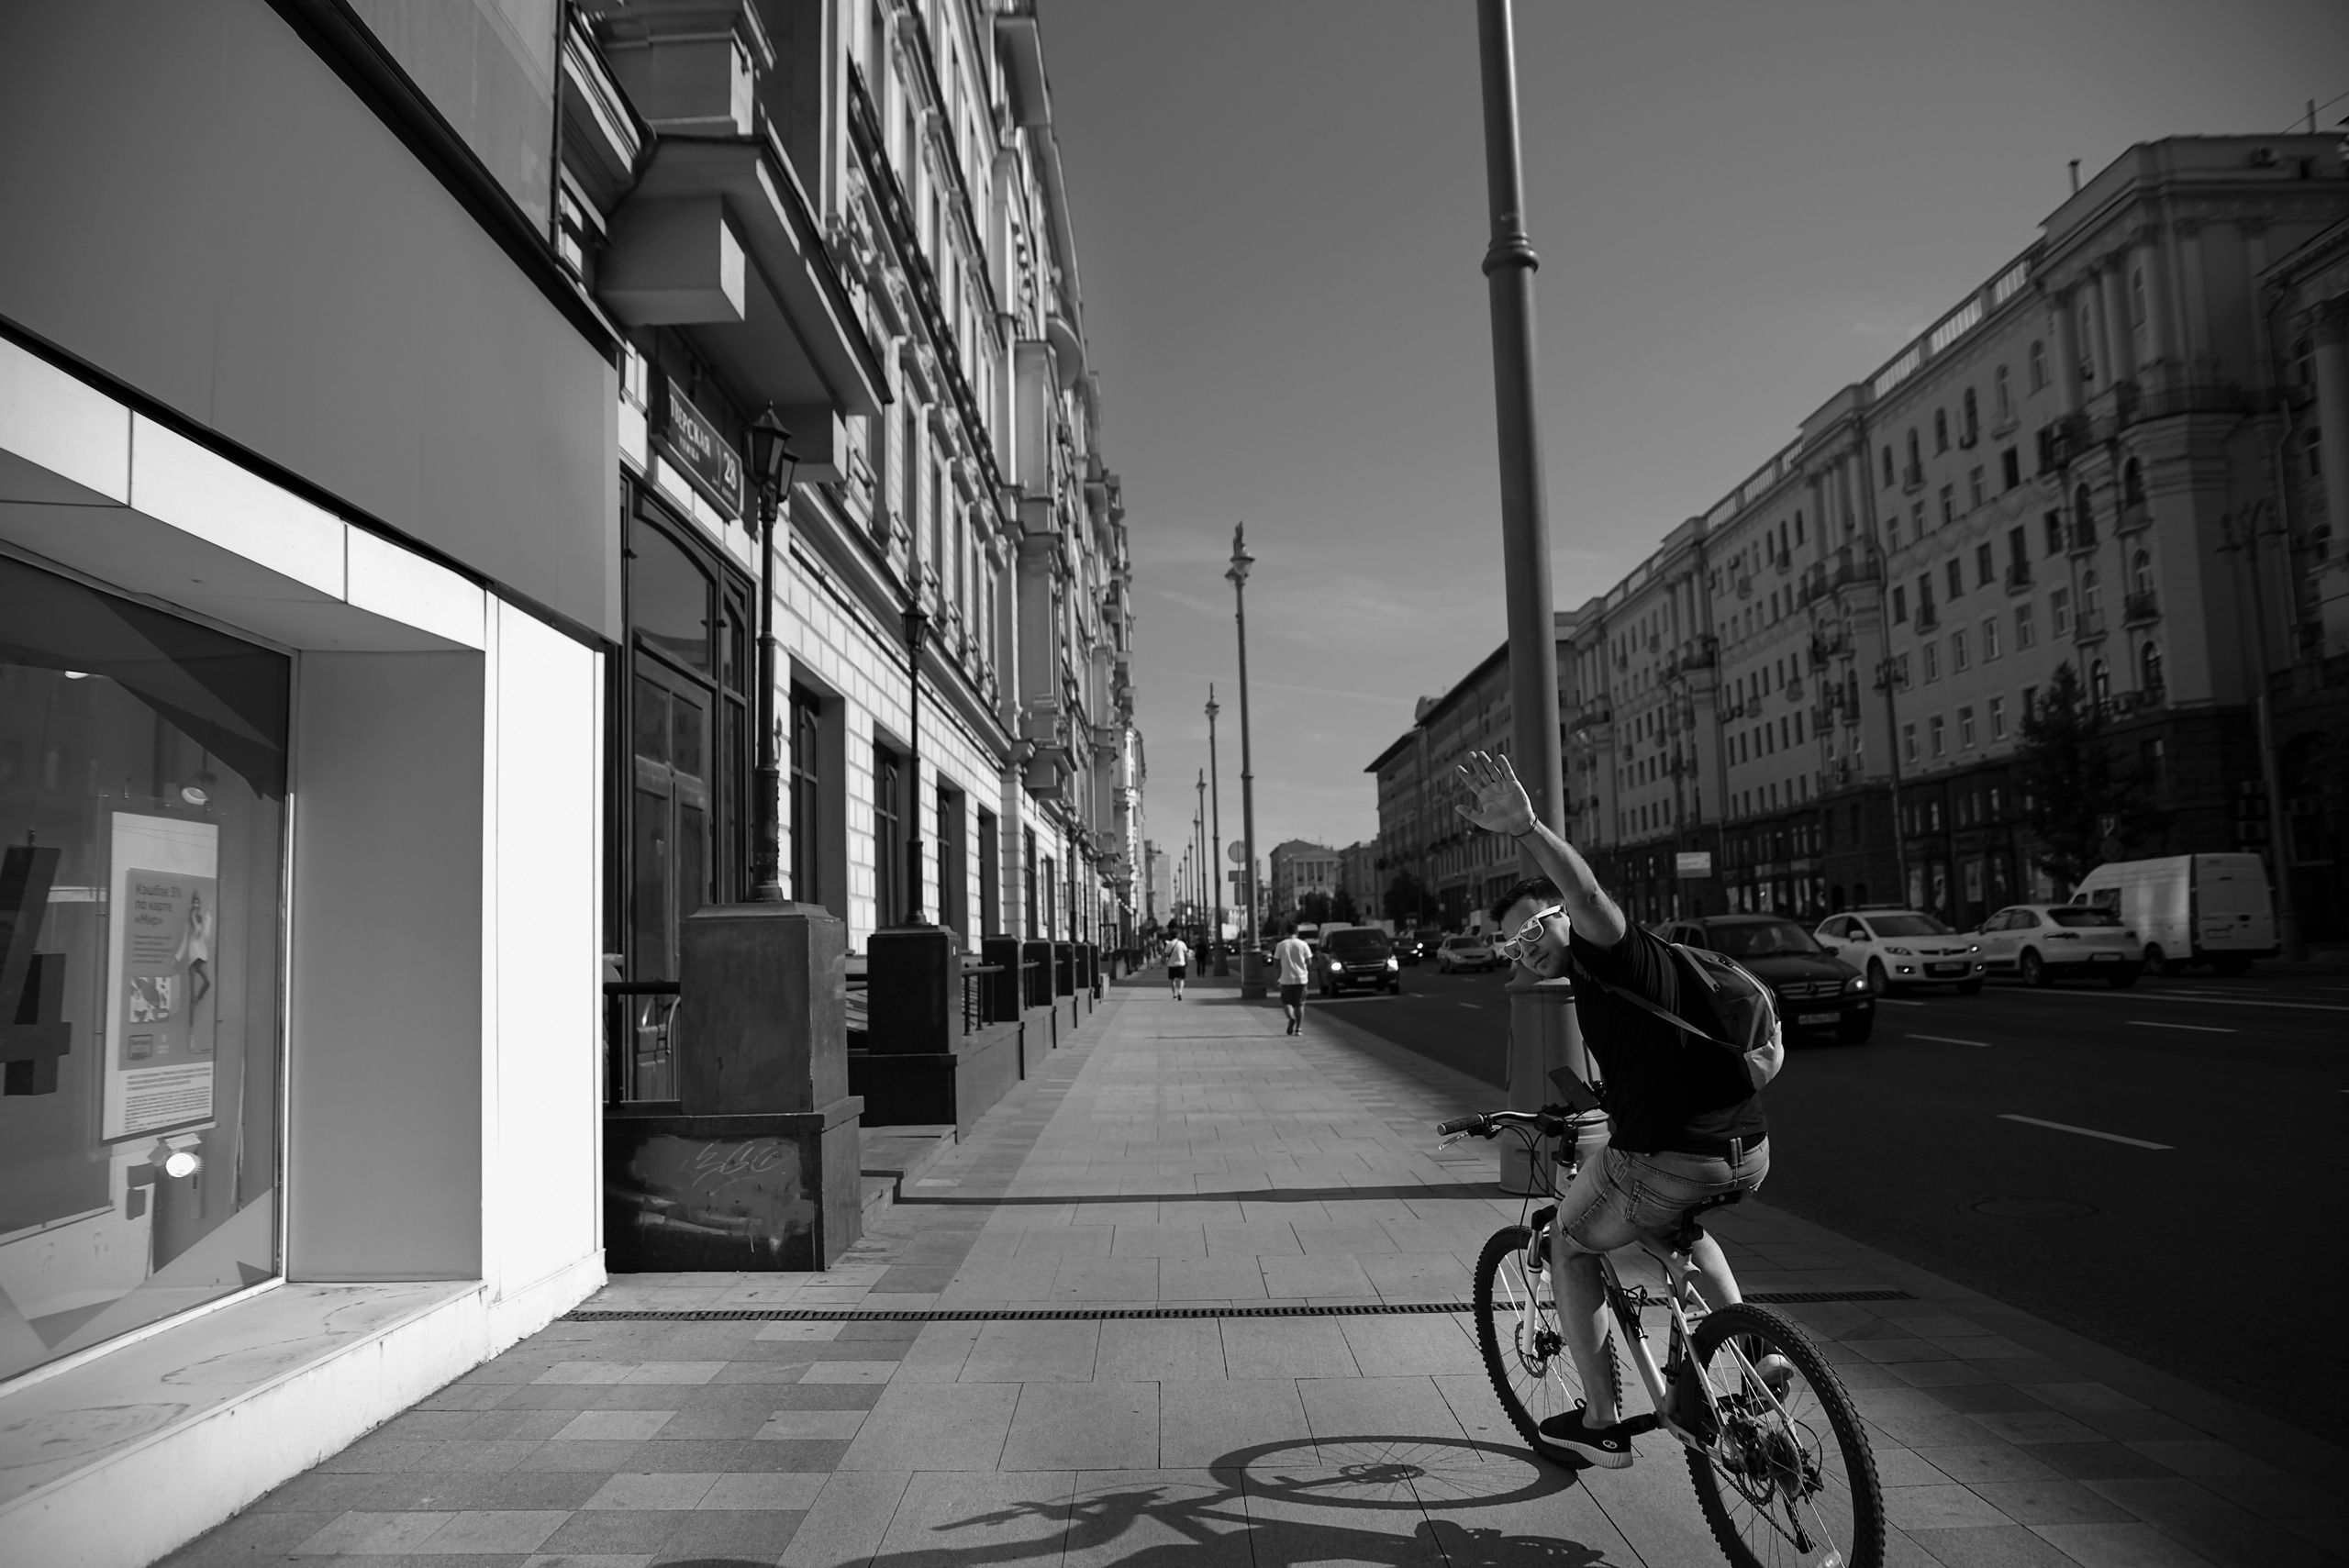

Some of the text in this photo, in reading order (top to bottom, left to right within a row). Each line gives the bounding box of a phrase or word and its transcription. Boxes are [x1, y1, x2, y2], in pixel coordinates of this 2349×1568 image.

[669, 394, 711, 458] ТВЕРСКАЯ
[723, 451, 737, 490] 28
[135, 883, 183, 898] Кэшбэк 5%
[134, 900, 173, 914] по карте
[134, 913, 163, 927] «Мир»
